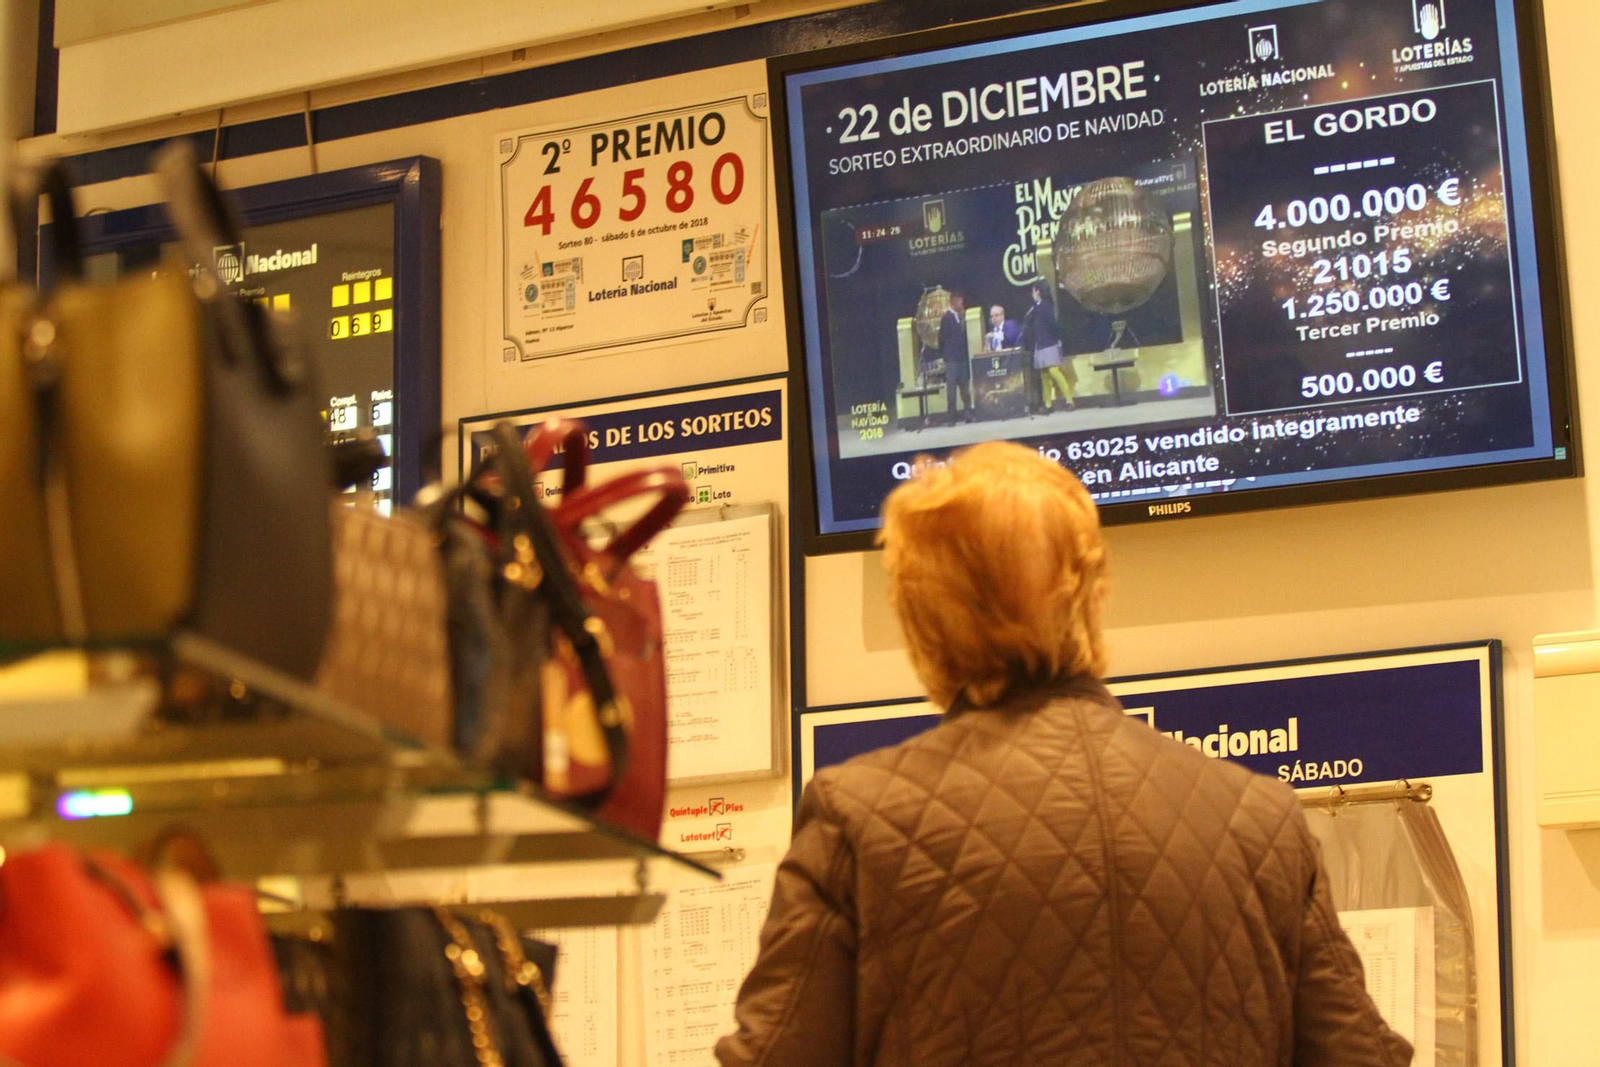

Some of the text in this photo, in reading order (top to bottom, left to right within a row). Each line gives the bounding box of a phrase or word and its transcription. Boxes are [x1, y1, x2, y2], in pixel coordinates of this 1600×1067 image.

[1391, 37, 1473, 63] LOTERÍAS
[1446, 55, 1474, 65] ESTADO
[1200, 64, 1335, 97] LOTERÍA NACIONAL
[838, 60, 1148, 144] 22 de DICIEMBRE
[1263, 98, 1437, 144] EL GORDO
[541, 111, 726, 176] 2º PREMIO
[828, 109, 1165, 175] SORTEO EXTRAORDINARIO DE NAVIDAD
[1015, 176, 1082, 221] EL MAY
[1253, 178, 1462, 231] 4.000.000 €
[558, 239, 582, 250] Sorteo
[584, 236, 593, 245] 80
[601, 232, 628, 243] sábado
[630, 230, 635, 238] 6
[637, 228, 646, 237] de
[648, 224, 677, 235] octubre
[679, 219, 689, 230] de
[690, 217, 708, 228] 2018
[1261, 218, 1460, 258] Segundo Premio
[245, 243, 317, 275] Nacional
[1312, 248, 1412, 284] 21015
[341, 268, 382, 282] Reintegros
[588, 276, 678, 303] Lotería Nacional
[1282, 278, 1451, 321] 1.250.000 €
[1296, 311, 1440, 342] Tercer Premio
[1301, 361, 1444, 398] 500.000 €
[330, 389, 393, 408] Compl. Reint.
[851, 400, 887, 415] LOTERÍA
[605, 406, 772, 446] DE LOS SORTEOS
[851, 414, 889, 429] NAVIDAD
[859, 427, 884, 440] 2018
[1066, 435, 1140, 461] 63025
[1145, 426, 1246, 451] vendido
[1252, 405, 1421, 440] integramente
[698, 463, 735, 476] Primitiva
[1082, 454, 1220, 485] en Alicante
[713, 490, 731, 500] Loto
[1148, 501, 1192, 516] PHILIPS
[1277, 758, 1363, 783] SÁBADO
[725, 802, 744, 813] Plus
[680, 831, 716, 842] Lototurf
